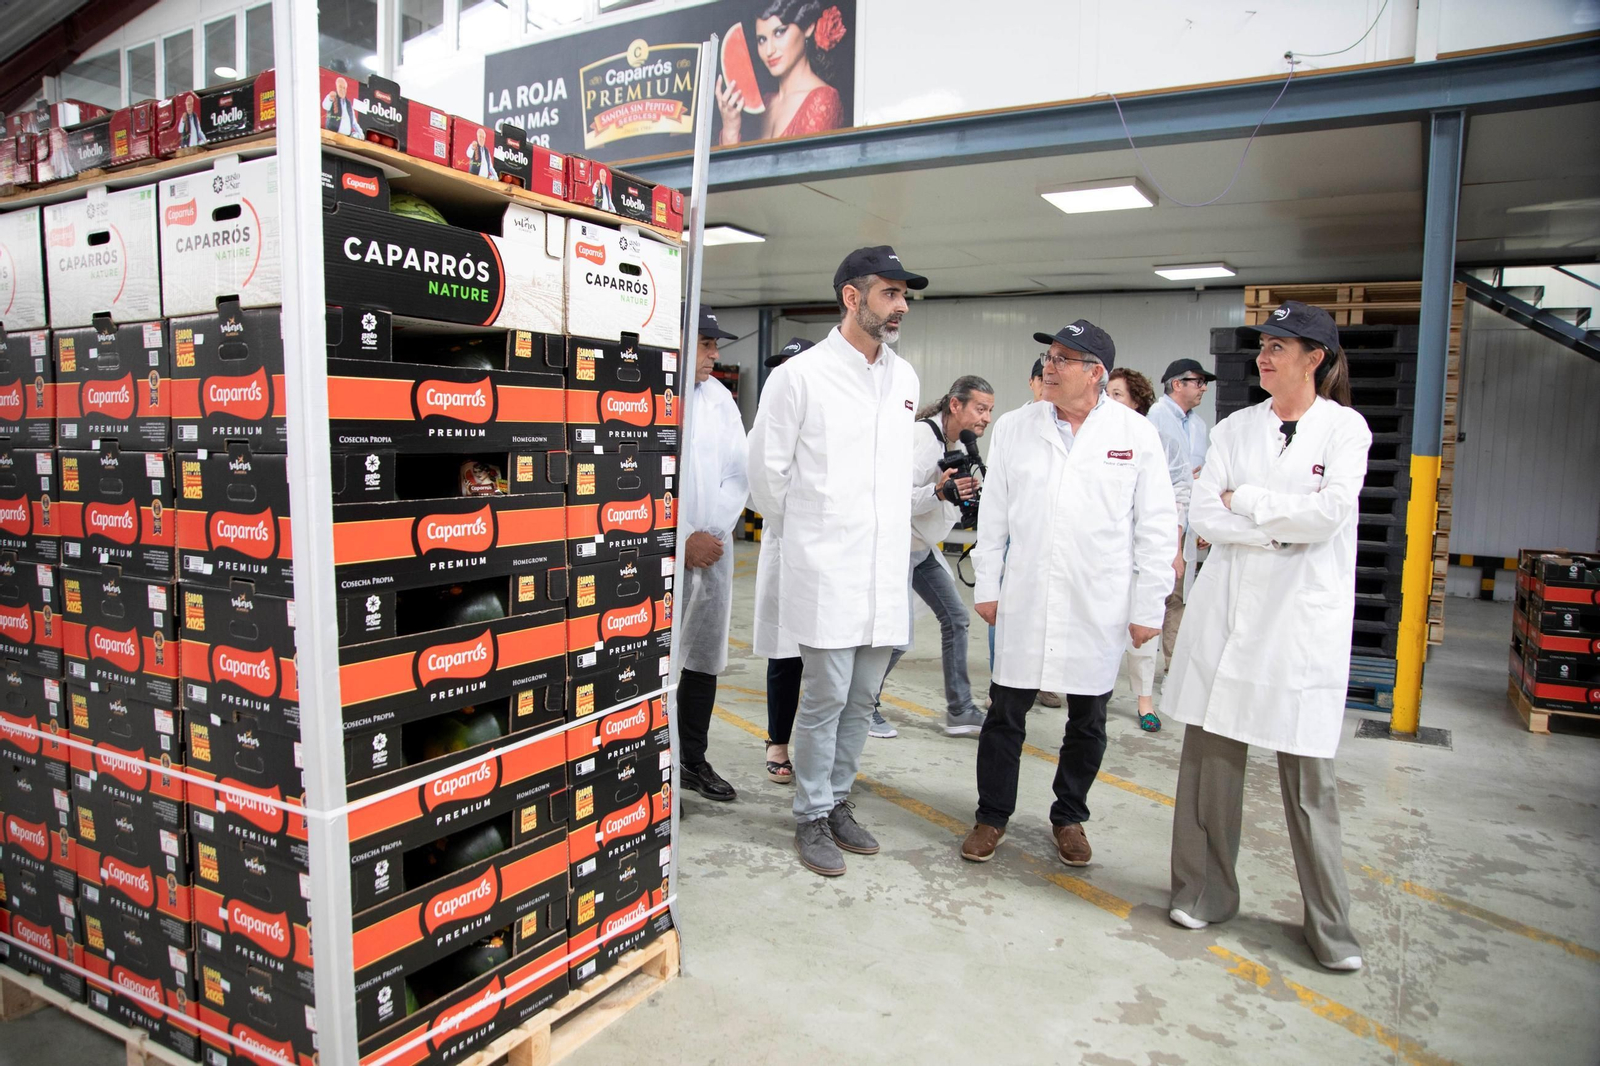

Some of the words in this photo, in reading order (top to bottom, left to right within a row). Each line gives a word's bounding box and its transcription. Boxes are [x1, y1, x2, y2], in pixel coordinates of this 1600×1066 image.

[605, 59, 672, 86] Caparrós
[489, 87, 511, 114] LA
[515, 77, 568, 108] ROJA
[586, 71, 692, 109] PREMIUM
[210, 107, 243, 126] Lobello
[363, 98, 402, 122] Lobello
[528, 108, 559, 129] MÁS
[601, 106, 629, 124] SANDÍA
[630, 104, 643, 112] SIN
[645, 102, 674, 112] PEPITAS
[618, 113, 657, 126] SEEDLESS
[78, 143, 103, 160] Lobello
[347, 177, 376, 191] Caparrós
[168, 206, 194, 220] Caparrós
[621, 194, 645, 212] Lobello
[176, 224, 250, 253] CAPARRÓS
[59, 247, 118, 272] CAPARRÓS
[215, 247, 250, 260] NATURE
[344, 237, 490, 283] CAPARRÓS
[579, 245, 603, 259] Caparrós
[429, 280, 489, 303] NATURE
[586, 272, 648, 295] CAPARRÓS
[620, 294, 648, 306] NATURE
[176, 353, 195, 367] 2025
[576, 369, 595, 380] 2025
[88, 385, 129, 408] Caparrós
[210, 380, 262, 406] Caparrós
[426, 388, 486, 410] Caparrós
[607, 397, 648, 415] Caparrós
[89, 425, 129, 433] PREMIUM
[212, 427, 262, 435] PREMIUM
[370, 435, 392, 443] PROPIA
[429, 429, 485, 437] PREMIUM
[184, 486, 203, 499] 2025
[577, 483, 595, 495] 2025
[91, 510, 133, 530] Caparrós
[607, 504, 648, 525] Caparrós
[217, 520, 268, 542] Caparrós
[427, 517, 486, 542] Caparrós
[92, 547, 132, 558] PREMIUM
[609, 537, 648, 548] PREMIUM
[218, 561, 268, 573] PREMIUM
[430, 557, 487, 571] PREMIUM
[513, 557, 547, 566] HOMEGROWN
[341, 578, 371, 589] COSECHA
[372, 576, 394, 586] PROPIA
[577, 594, 595, 608] 2025
[186, 618, 205, 631] 2025
[607, 607, 648, 631] Caparrós
[94, 633, 135, 656] Caparrós
[609, 640, 648, 655] PREMIUM
[220, 654, 270, 680] Caparrós
[428, 642, 487, 672] Caparrós
[97, 669, 136, 685] PREMIUM
[512, 673, 547, 686] HOMEGROWN
[430, 681, 487, 701] PREMIUM
[221, 693, 270, 712] PREMIUM
[576, 702, 594, 717] 2025
[343, 718, 372, 730] COSECHA
[373, 711, 395, 722] PROPIA
[606, 709, 645, 735] Caparrós
[3, 750, 36, 765] PREMIUM
[192, 747, 211, 762] 2025
[607, 740, 645, 759] PREMIUM
[434, 762, 490, 796] Caparrós
[103, 785, 142, 803] PREMIUM
[516, 782, 550, 800] HOMEGROWN
[437, 799, 490, 825] PREMIUM
[576, 805, 593, 821] 2025
[606, 804, 646, 834] Caparrós
[228, 824, 277, 847] PREMIUM
[608, 833, 646, 858] PREMIUM
[351, 848, 380, 864] COSECHA
[381, 839, 402, 853] PROPIA
[12, 853, 44, 871] PREMIUM
[108, 862, 149, 893] Caparrós
[200, 868, 219, 883] 2025
[434, 878, 491, 917] Caparrós
[516, 891, 550, 912] HOMEGROWN
[110, 897, 149, 920] PREMIUM
[578, 910, 595, 925] 2025
[234, 907, 284, 942] Caparrós
[437, 914, 491, 946] PREMIUM
[17, 922, 51, 950] Caparrós
[608, 930, 646, 958] PREMIUM
[19, 952, 51, 974] PREMIUM
[235, 944, 284, 972] PREMIUM
[354, 975, 381, 993] COSECHA
[383, 964, 403, 979] PROPIA
[205, 990, 224, 1007] 2025
[520, 994, 553, 1017] HOMEGROWN
[120, 1006, 160, 1031] PREMIUM
[443, 1022, 495, 1060] PREMIUM
